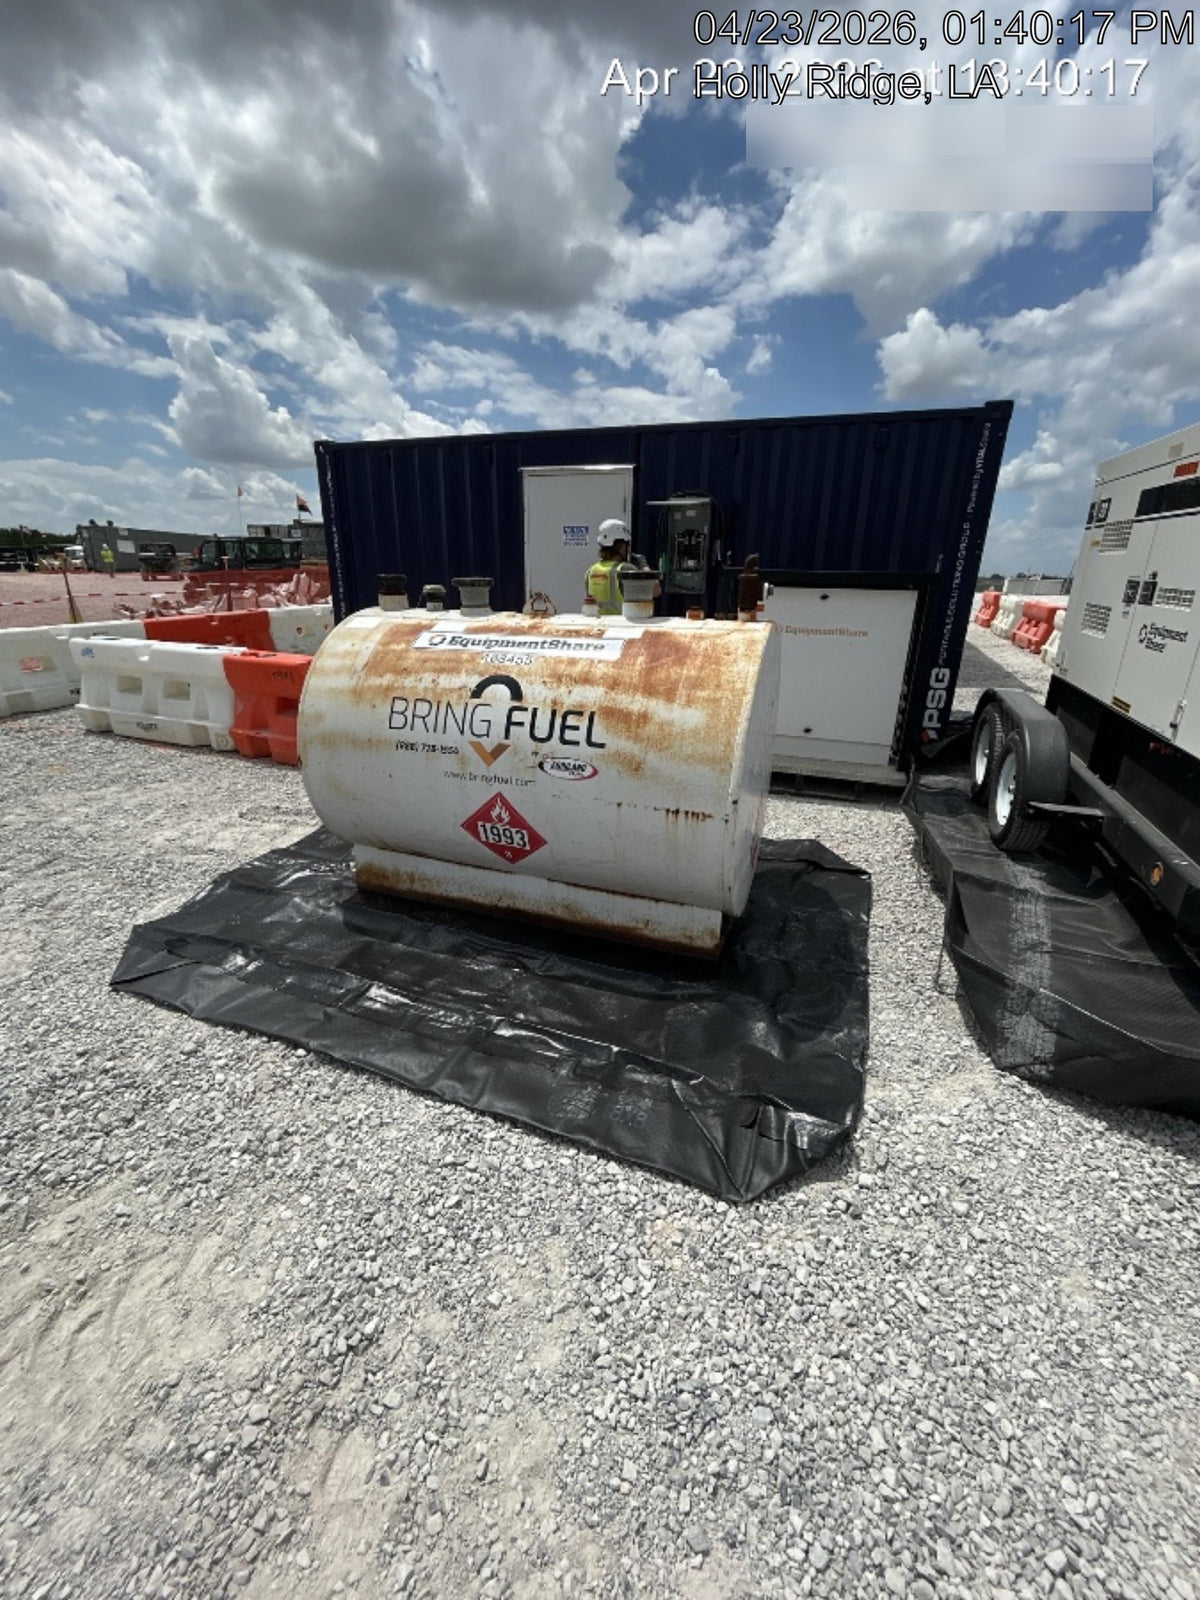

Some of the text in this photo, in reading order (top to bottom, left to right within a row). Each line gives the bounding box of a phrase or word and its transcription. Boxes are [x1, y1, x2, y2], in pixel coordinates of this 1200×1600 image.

[449, 635, 605, 651] EquipmentShare
[923, 667, 950, 728] PSG
[388, 696, 606, 749] BRING FUEL
[480, 823, 527, 848] 1993
